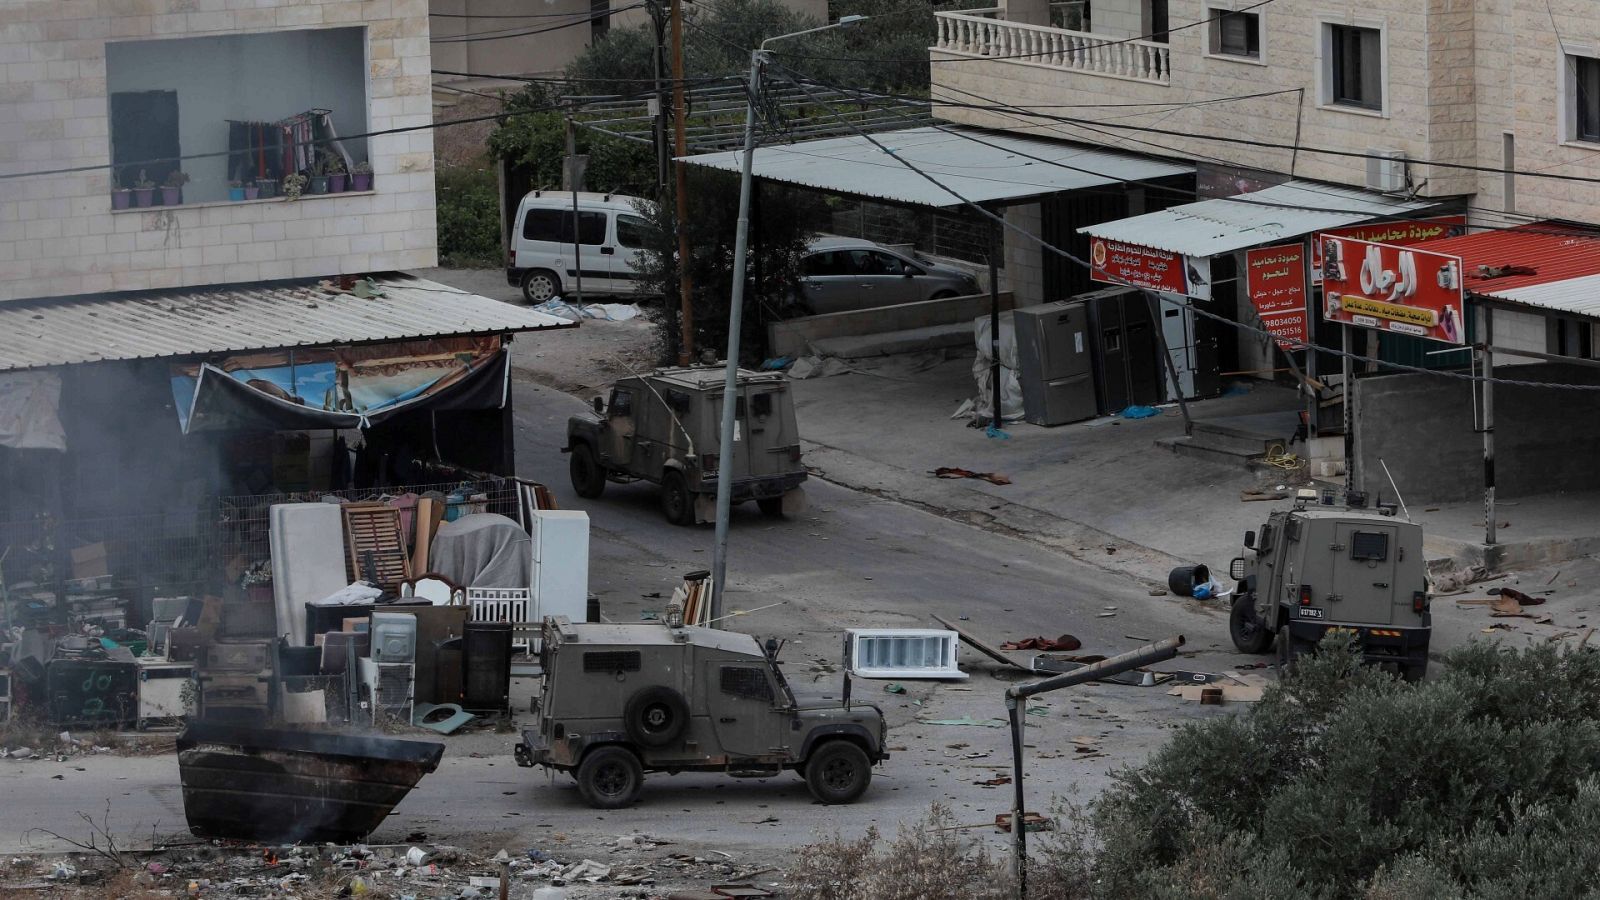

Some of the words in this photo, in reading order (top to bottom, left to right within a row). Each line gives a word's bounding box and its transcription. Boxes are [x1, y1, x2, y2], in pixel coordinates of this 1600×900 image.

[1409, 224, 1443, 241] حمودة
[1252, 256, 1277, 268] محاميد
[1278, 254, 1300, 264] حمودة
[1262, 268, 1289, 281] للحوم
[1264, 316, 1302, 328] 98034050
[1268, 326, 1302, 336] 9051516
